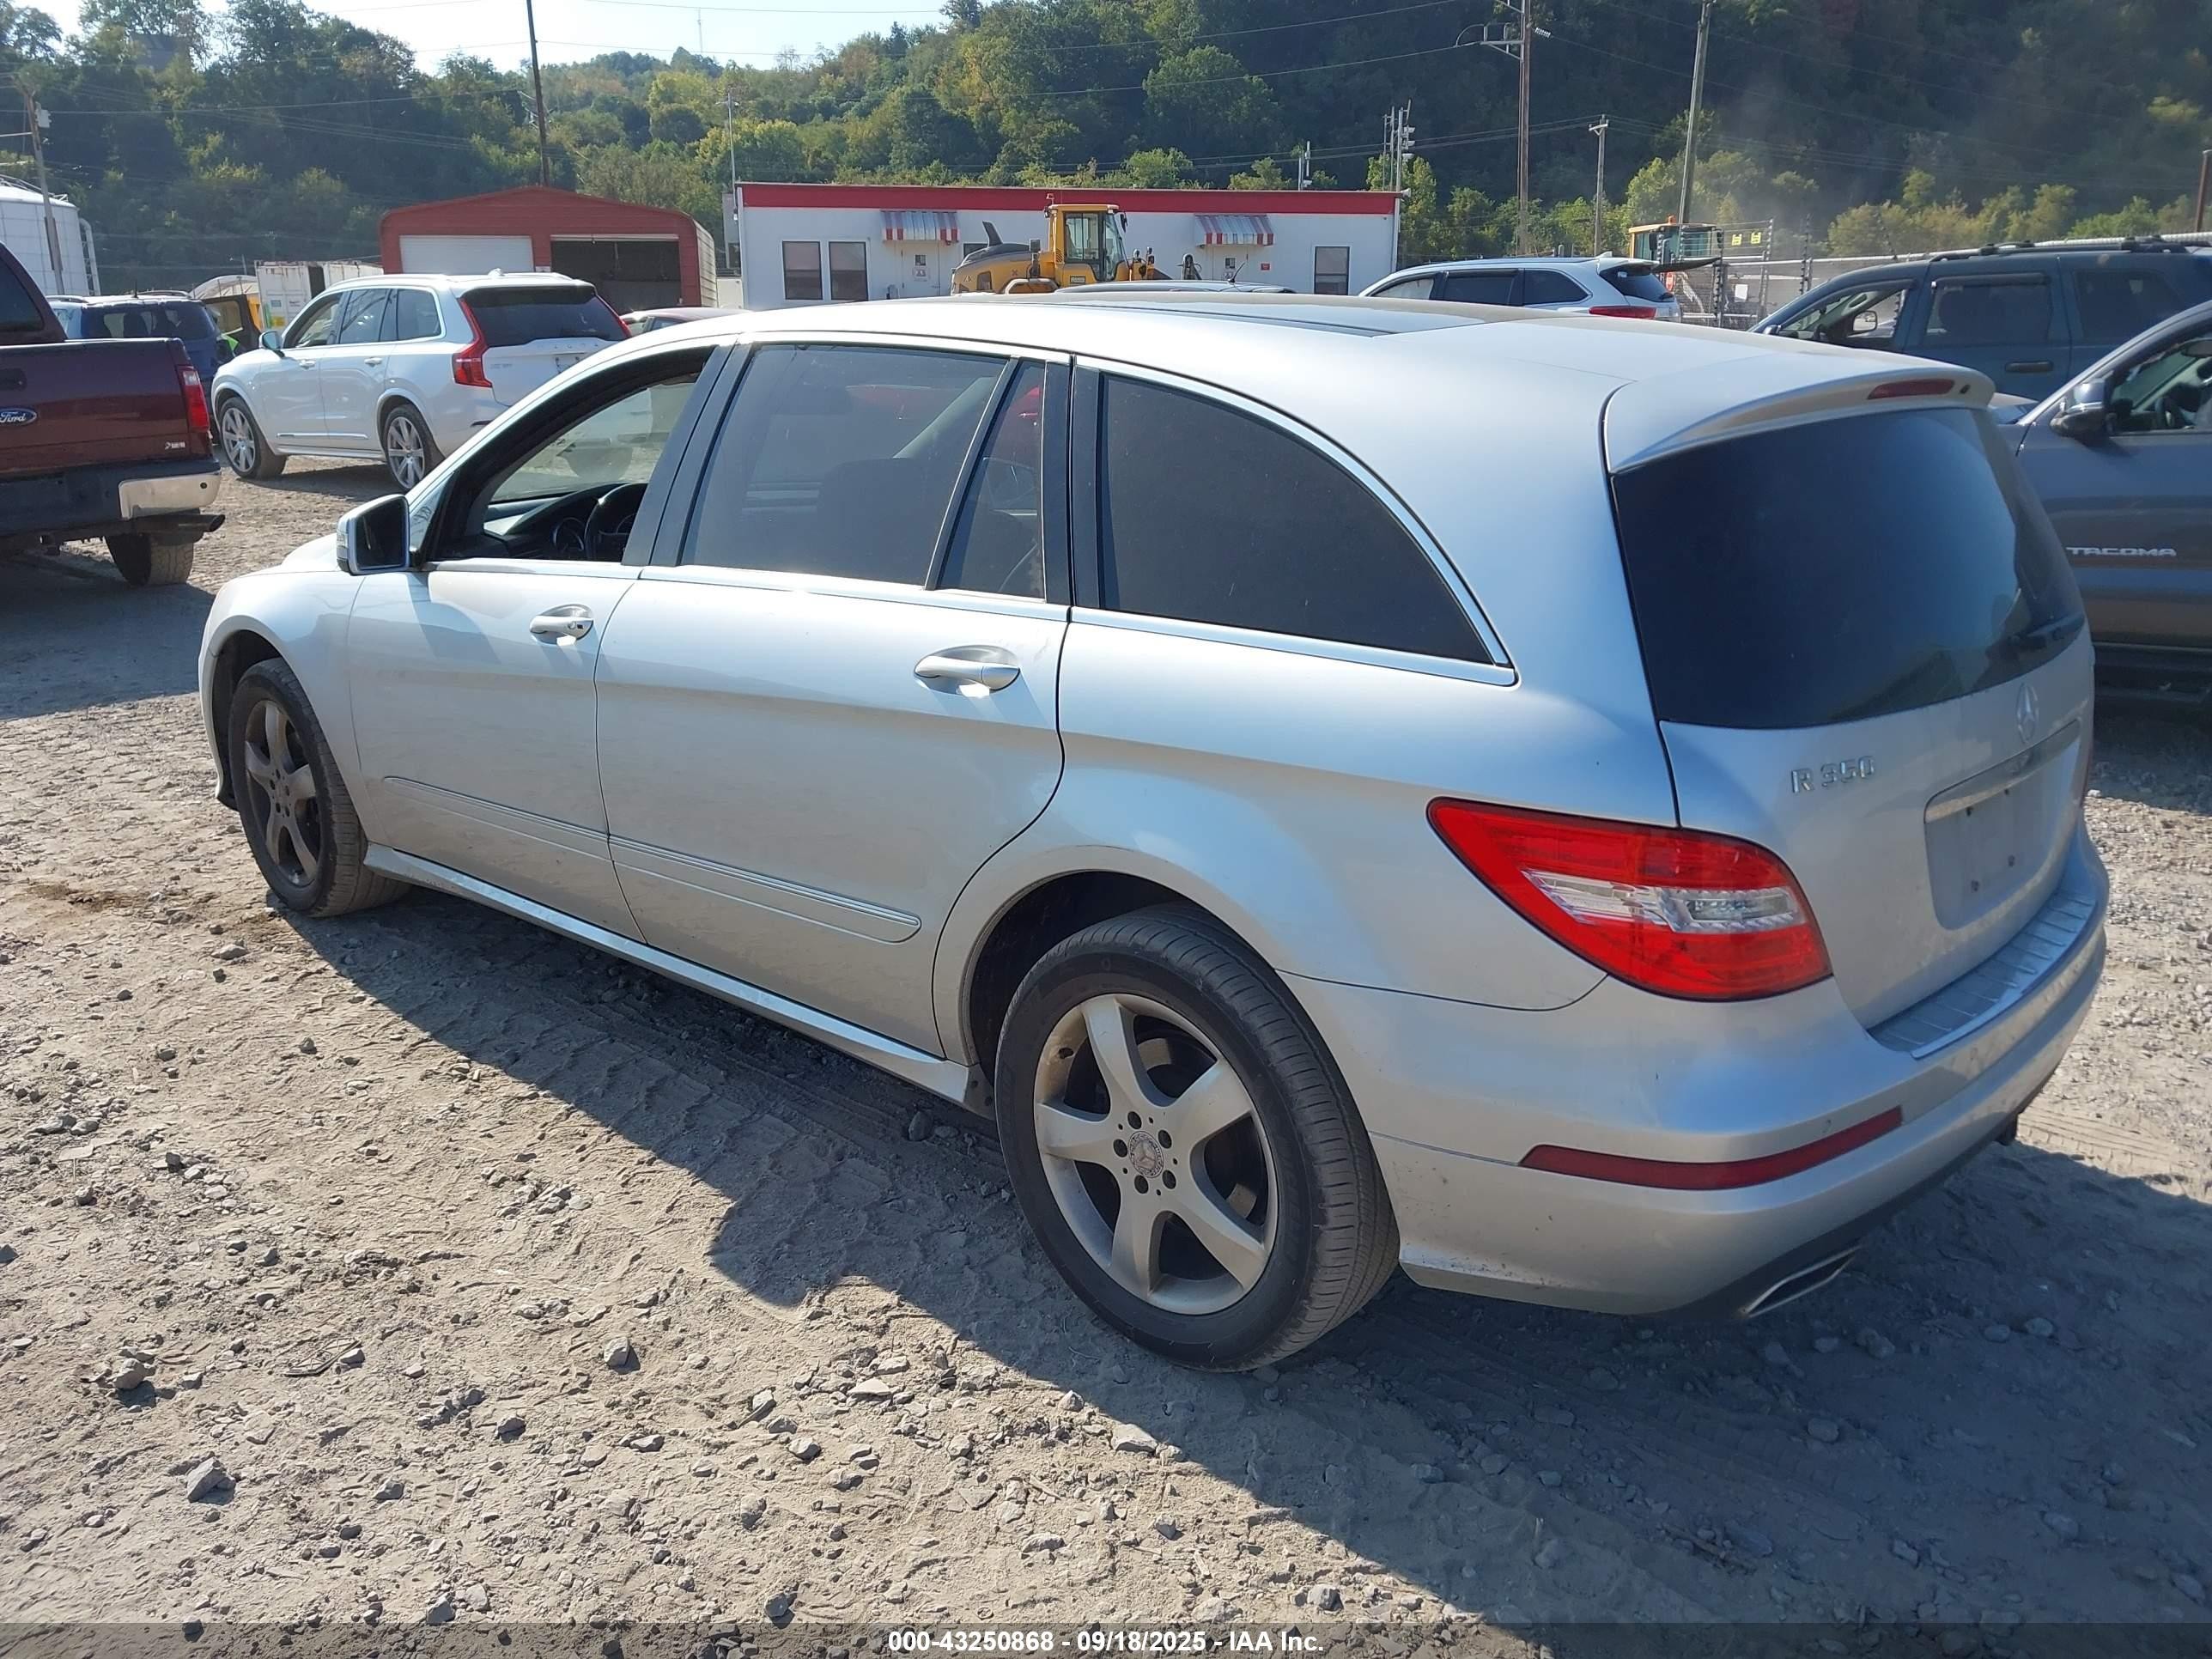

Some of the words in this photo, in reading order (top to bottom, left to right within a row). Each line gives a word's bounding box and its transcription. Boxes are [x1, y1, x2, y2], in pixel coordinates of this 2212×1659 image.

[2065, 547, 2177, 556] TACOMA
[1790, 769, 1814, 793] R
[1820, 756, 1875, 787] 350
